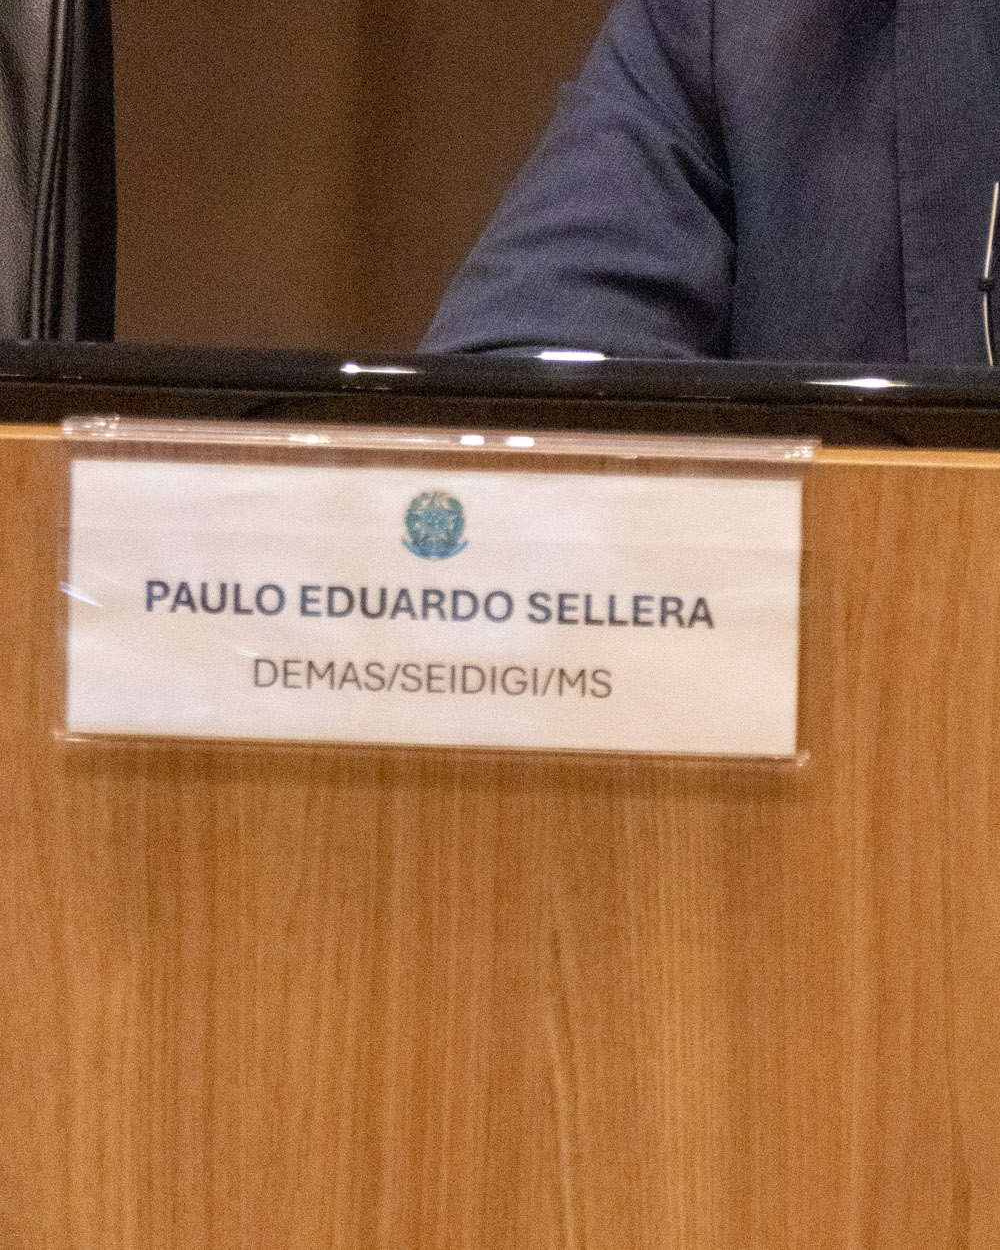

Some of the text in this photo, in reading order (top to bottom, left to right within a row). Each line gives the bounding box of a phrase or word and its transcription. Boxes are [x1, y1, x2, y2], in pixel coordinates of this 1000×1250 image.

[146, 580, 714, 629] PAULO EDUARDO SELLERA
[253, 658, 612, 699] DEMAS/SEIDIGI/MS
